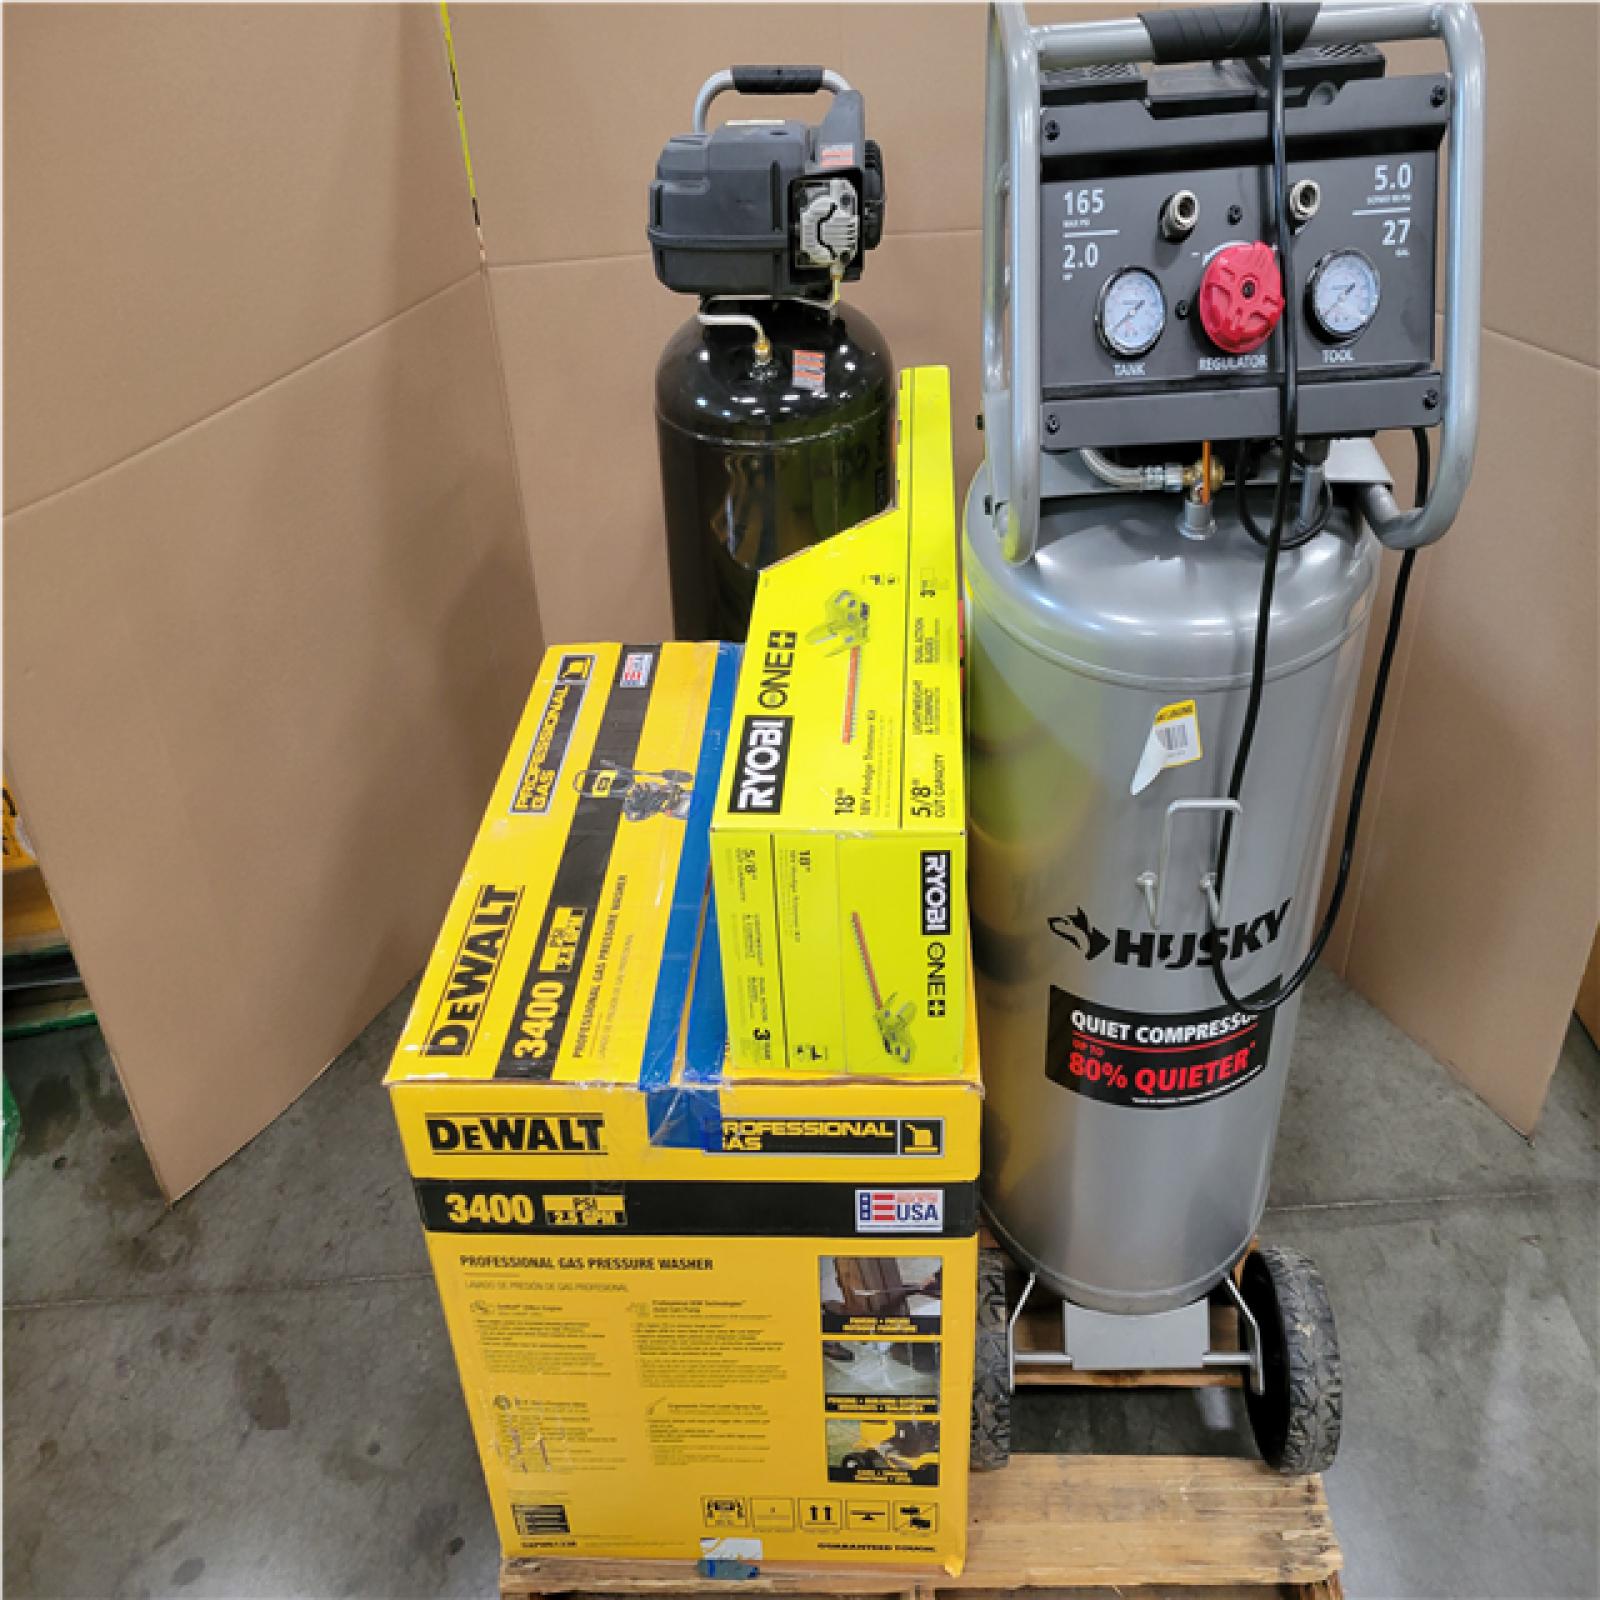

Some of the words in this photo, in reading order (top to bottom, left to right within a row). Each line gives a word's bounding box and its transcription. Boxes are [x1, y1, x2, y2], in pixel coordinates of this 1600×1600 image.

[1374, 162, 1412, 191] 5.0
[1063, 188, 1105, 216] 165
[1382, 219, 1411, 246] 27
[1062, 242, 1099, 269] 2.0
[1112, 363, 1146, 376] TANK
[1197, 354, 1268, 371] REGULATOR
[514, 684, 570, 809] PROFESSIONAL
[737, 718, 786, 811] RYOBI
[531, 769, 556, 810] GAS
[925, 853, 947, 932] RYOBI
[1114, 897, 1293, 970] HUSKY
[512, 979, 566, 1060] 3400
[1070, 1009, 1131, 1041] QUIET
[752, 1027, 771, 1041] 3
[1069, 1051, 1128, 1090] 80%
[722, 1120, 894, 1136] ROFESSIONAL
[722, 1136, 762, 1150] AS
[444, 1192, 536, 1225] 3400
[896, 1203, 939, 1222] USA
[459, 1254, 555, 1269] PROFESSIONAL
[557, 1256, 586, 1270] GAS
[587, 1257, 656, 1271] PRESSURE
[658, 1257, 713, 1271] WASHER
